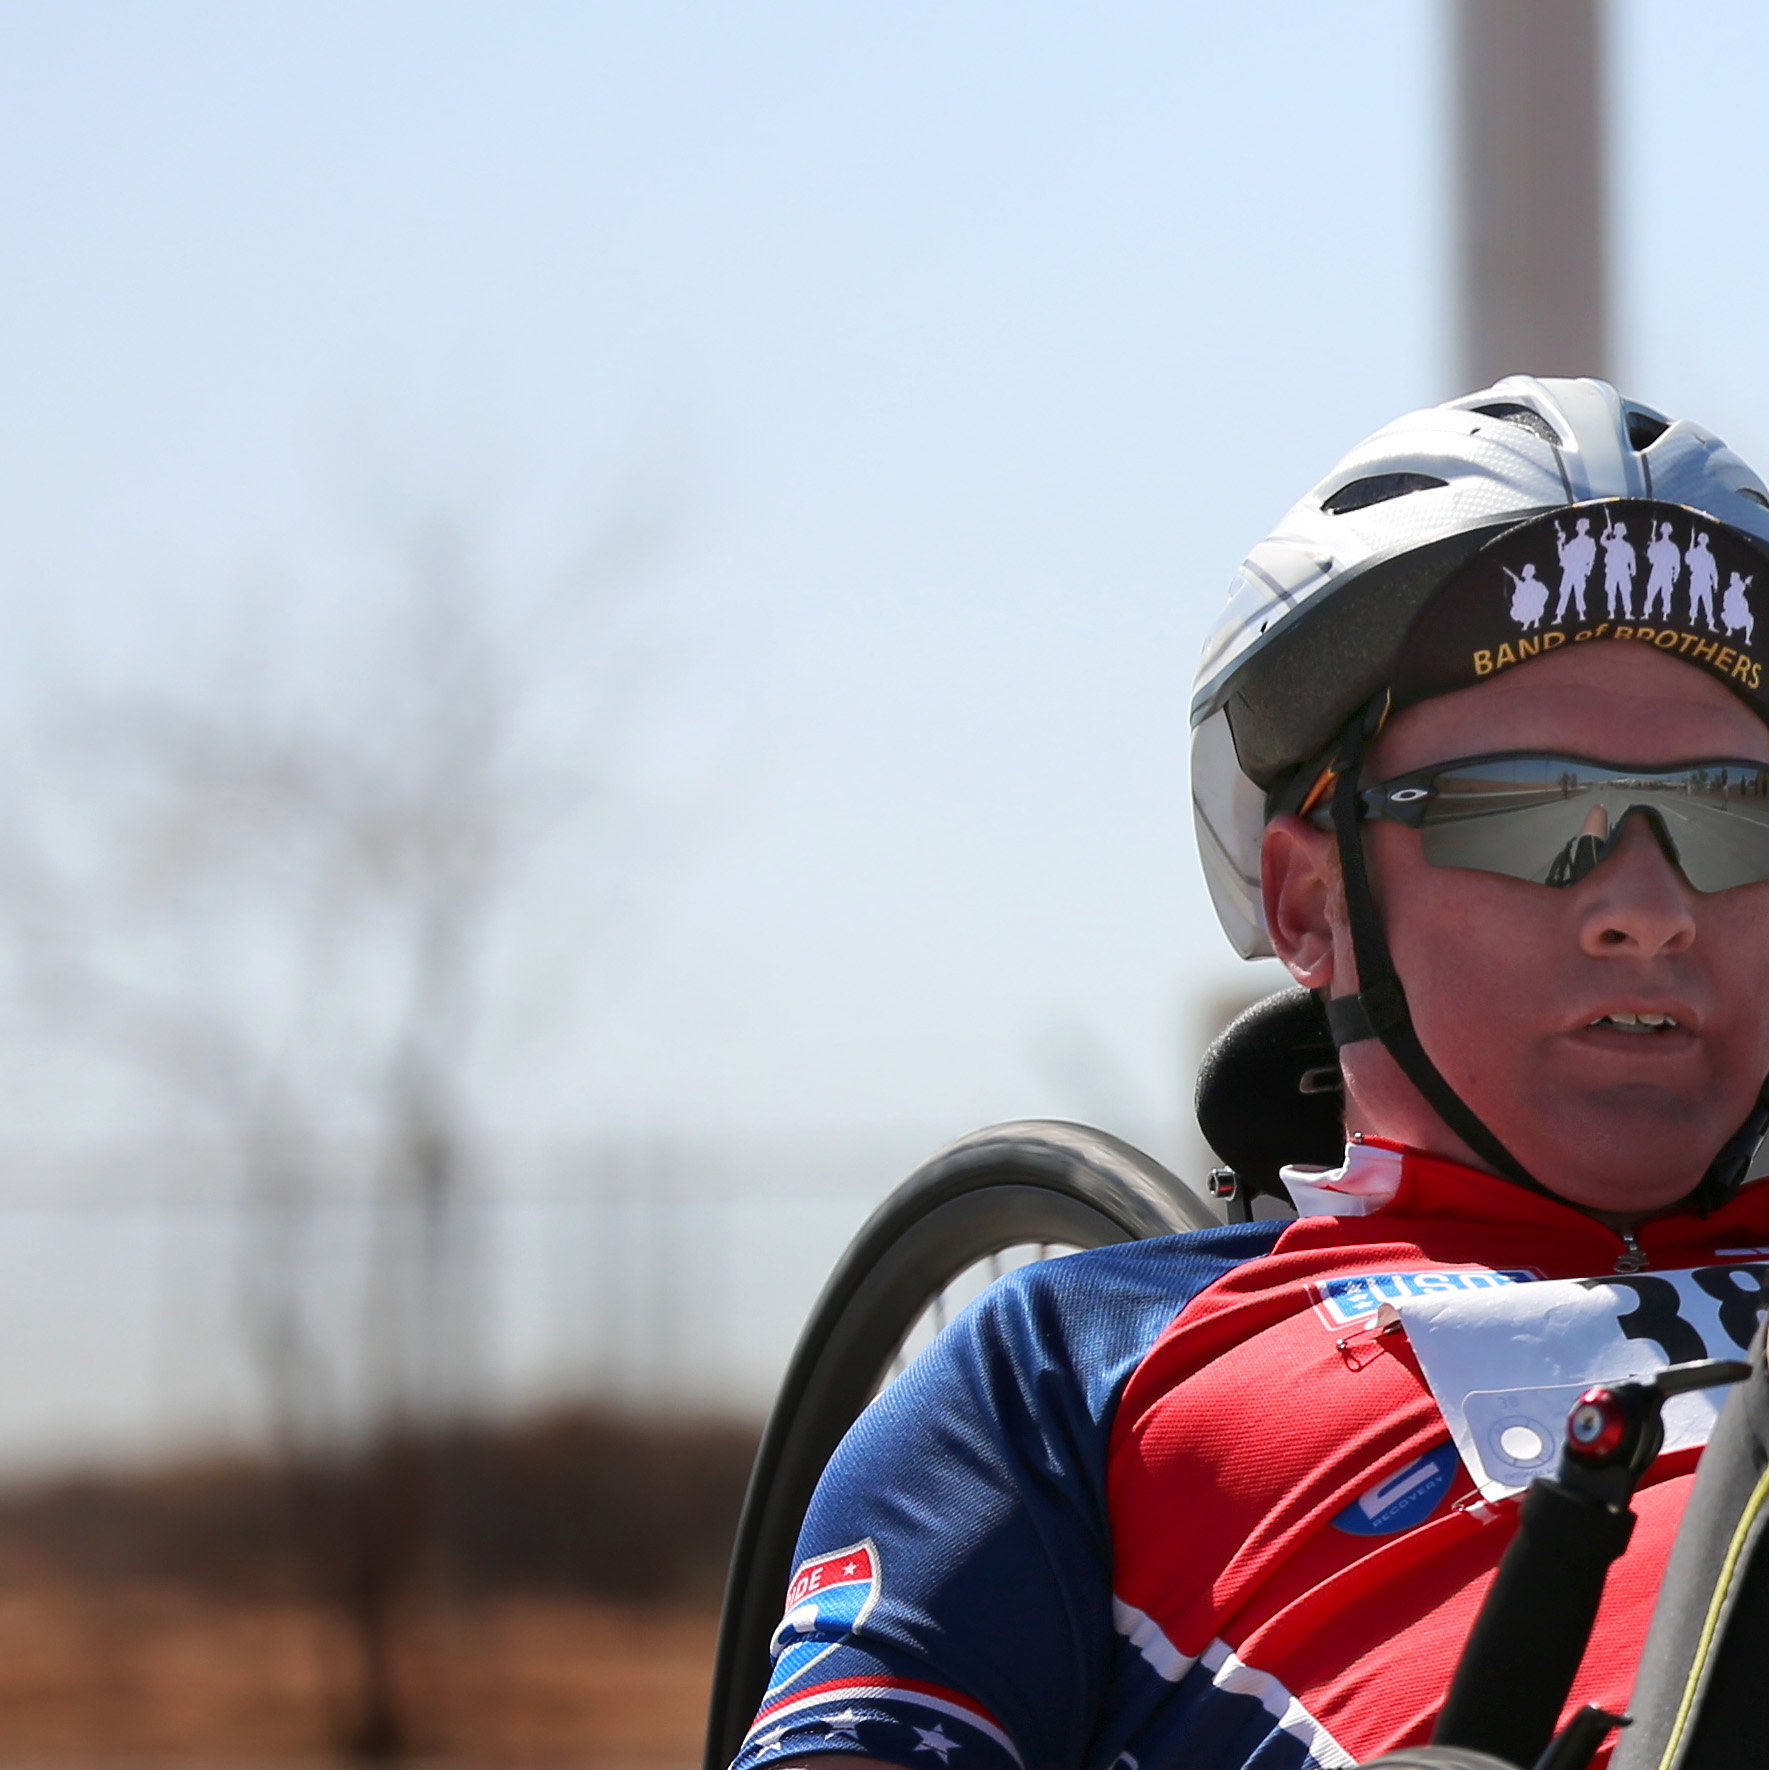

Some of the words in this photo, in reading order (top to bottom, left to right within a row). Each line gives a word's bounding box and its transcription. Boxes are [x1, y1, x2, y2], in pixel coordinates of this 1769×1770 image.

[1473, 631, 1565, 676] BAND
[1575, 623, 1609, 642] of
[1366, 1273, 1502, 1302] USO
[1372, 1476, 1443, 1528] RECOVERY
[786, 1567, 824, 1606] IDE
